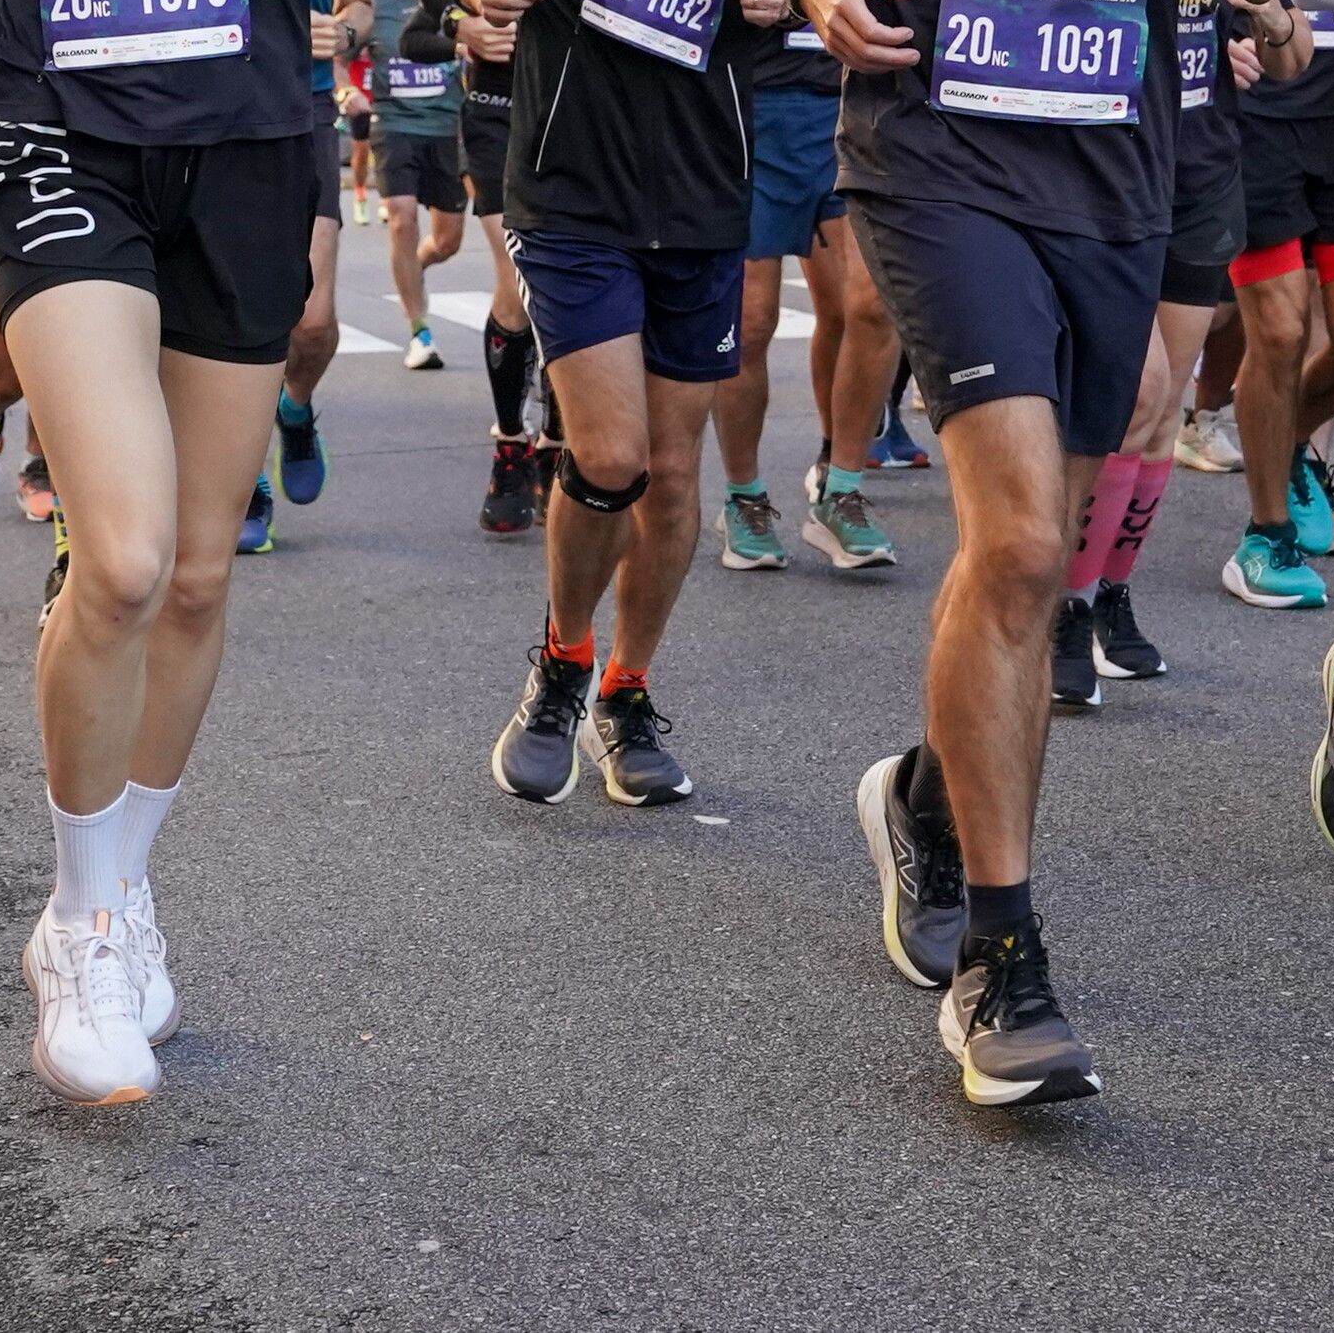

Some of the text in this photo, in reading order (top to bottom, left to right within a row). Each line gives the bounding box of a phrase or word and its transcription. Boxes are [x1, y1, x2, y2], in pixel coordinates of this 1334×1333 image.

[55, 48, 98, 59] SALOMON
[1037, 23, 1123, 76] 1031
[413, 67, 443, 85] 1315
[943, 88, 989, 102] SALOMON
